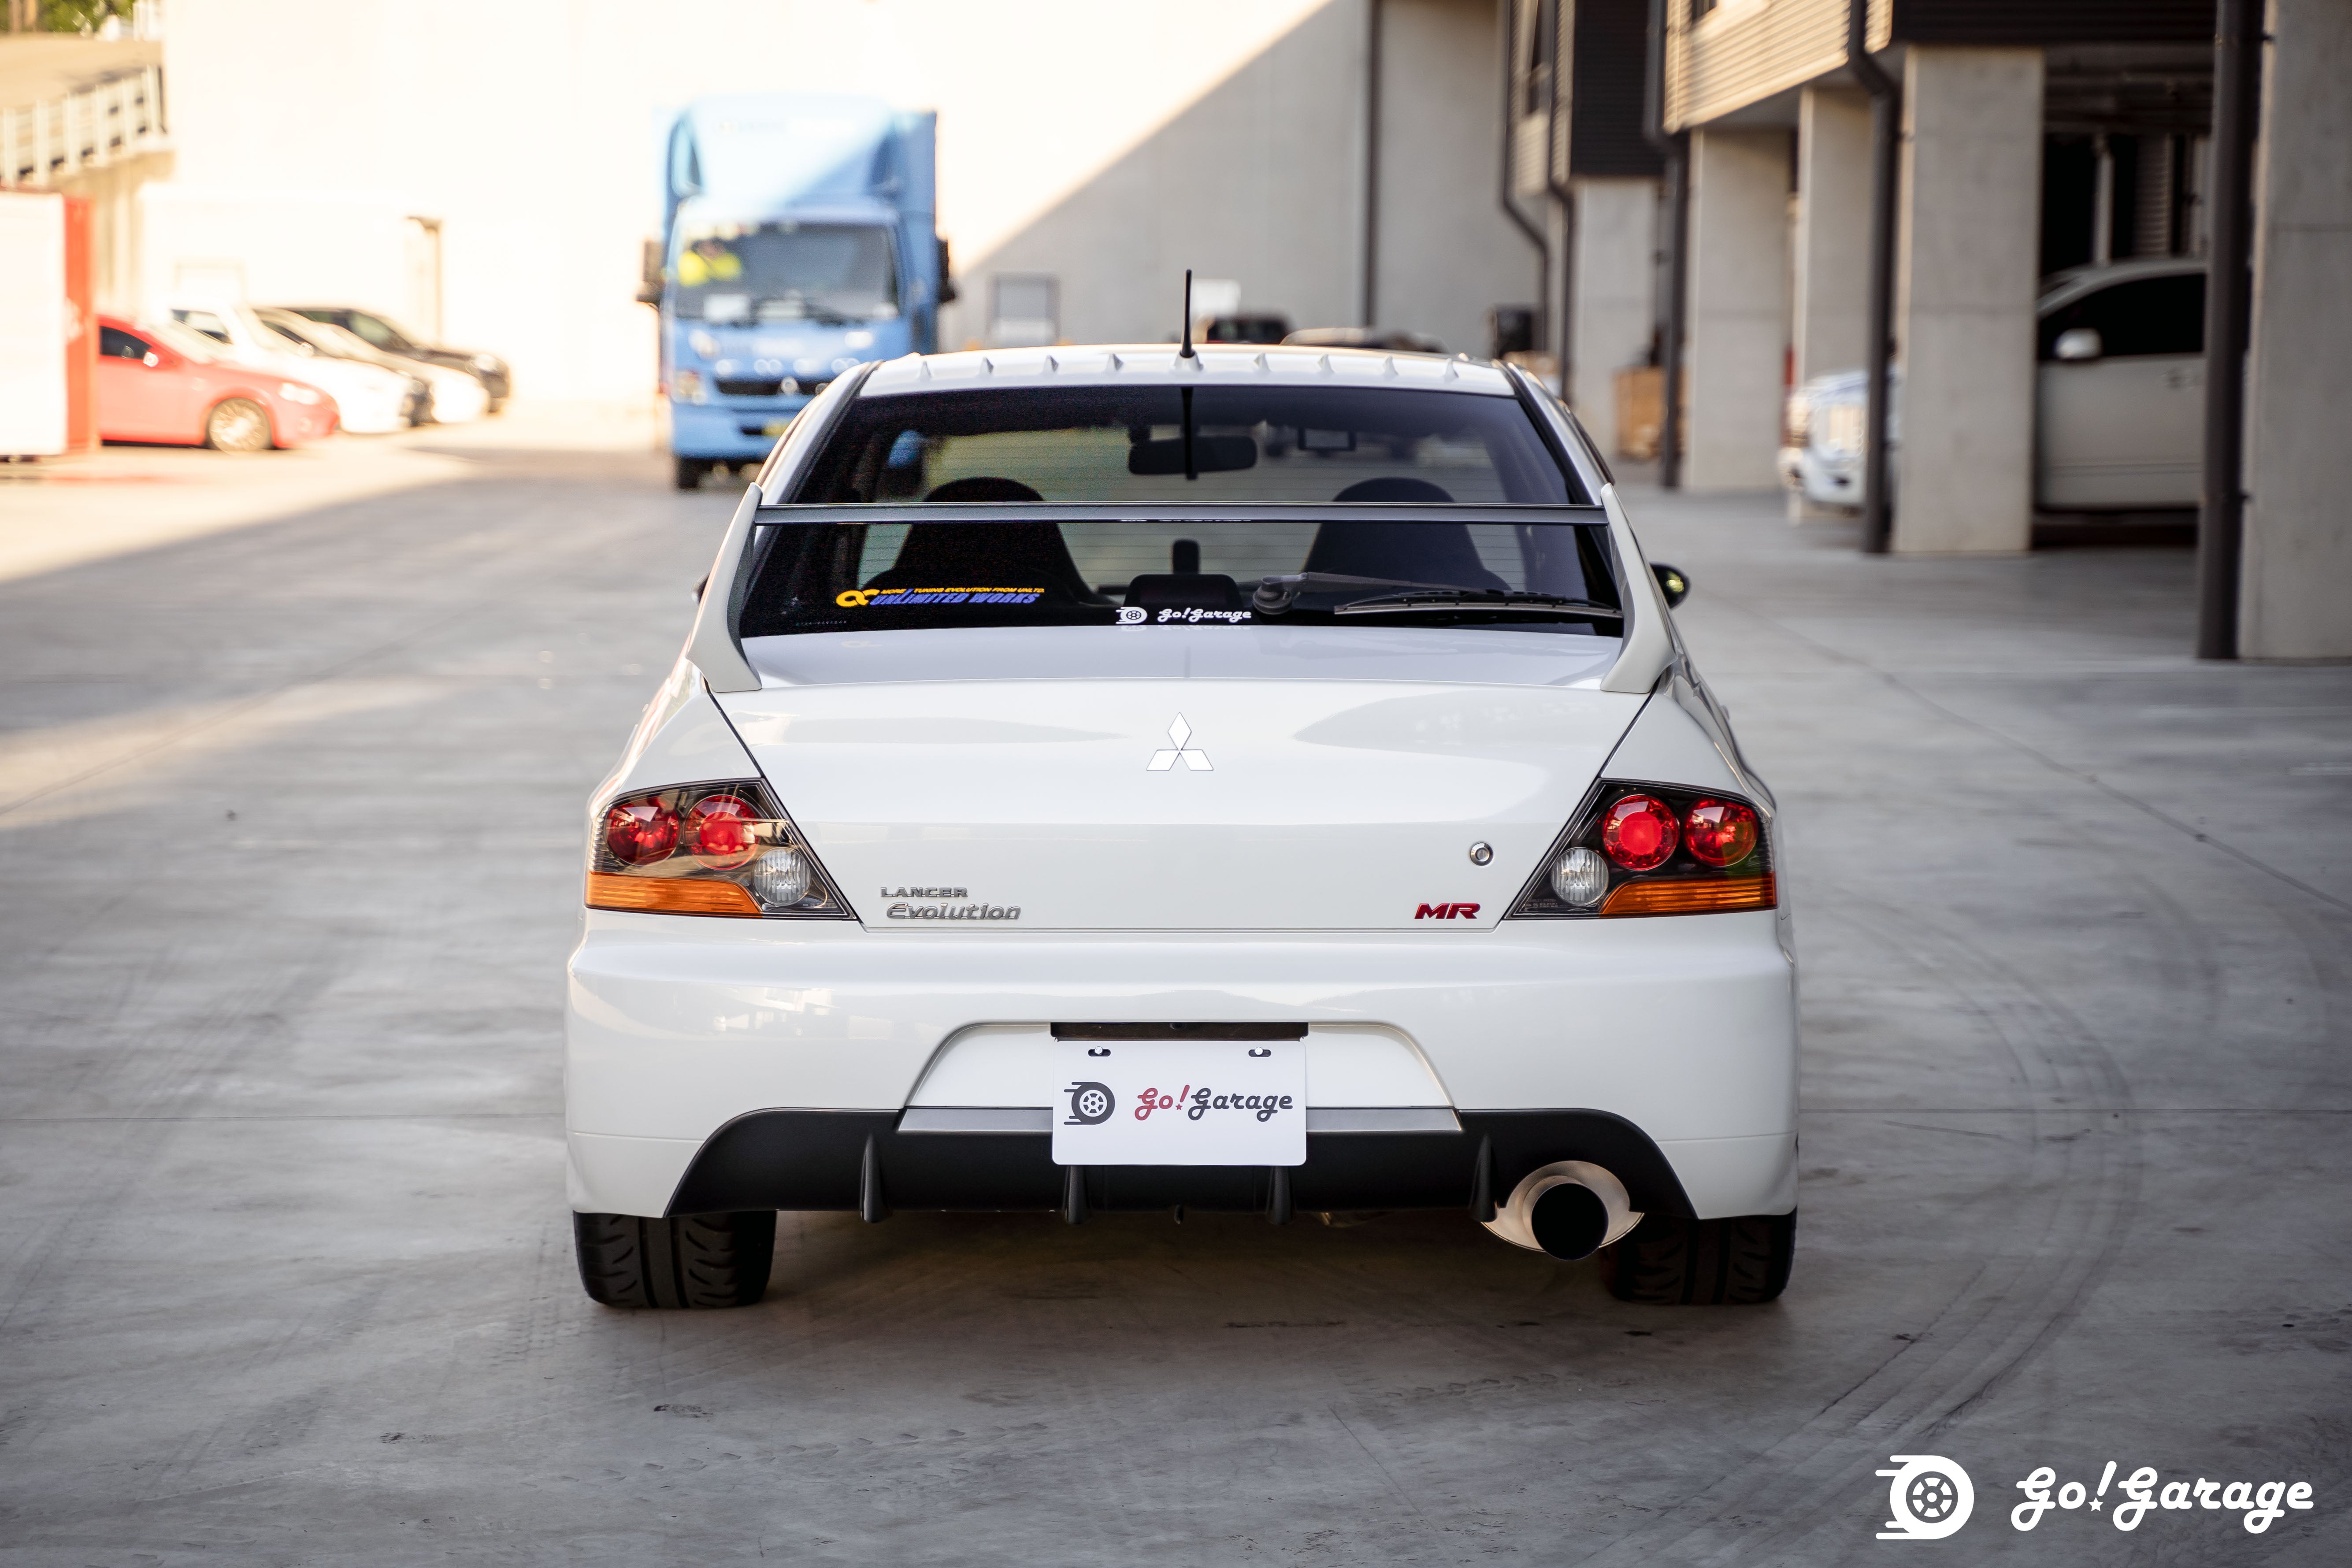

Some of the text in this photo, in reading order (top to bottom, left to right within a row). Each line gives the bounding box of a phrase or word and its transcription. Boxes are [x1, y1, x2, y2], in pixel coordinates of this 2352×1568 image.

[869, 589, 1040, 606] UNLIMITED WORKS
[881, 887, 968, 897] LANCER
[887, 902, 1021, 920] Evolution
[1414, 903, 1481, 919] MR
